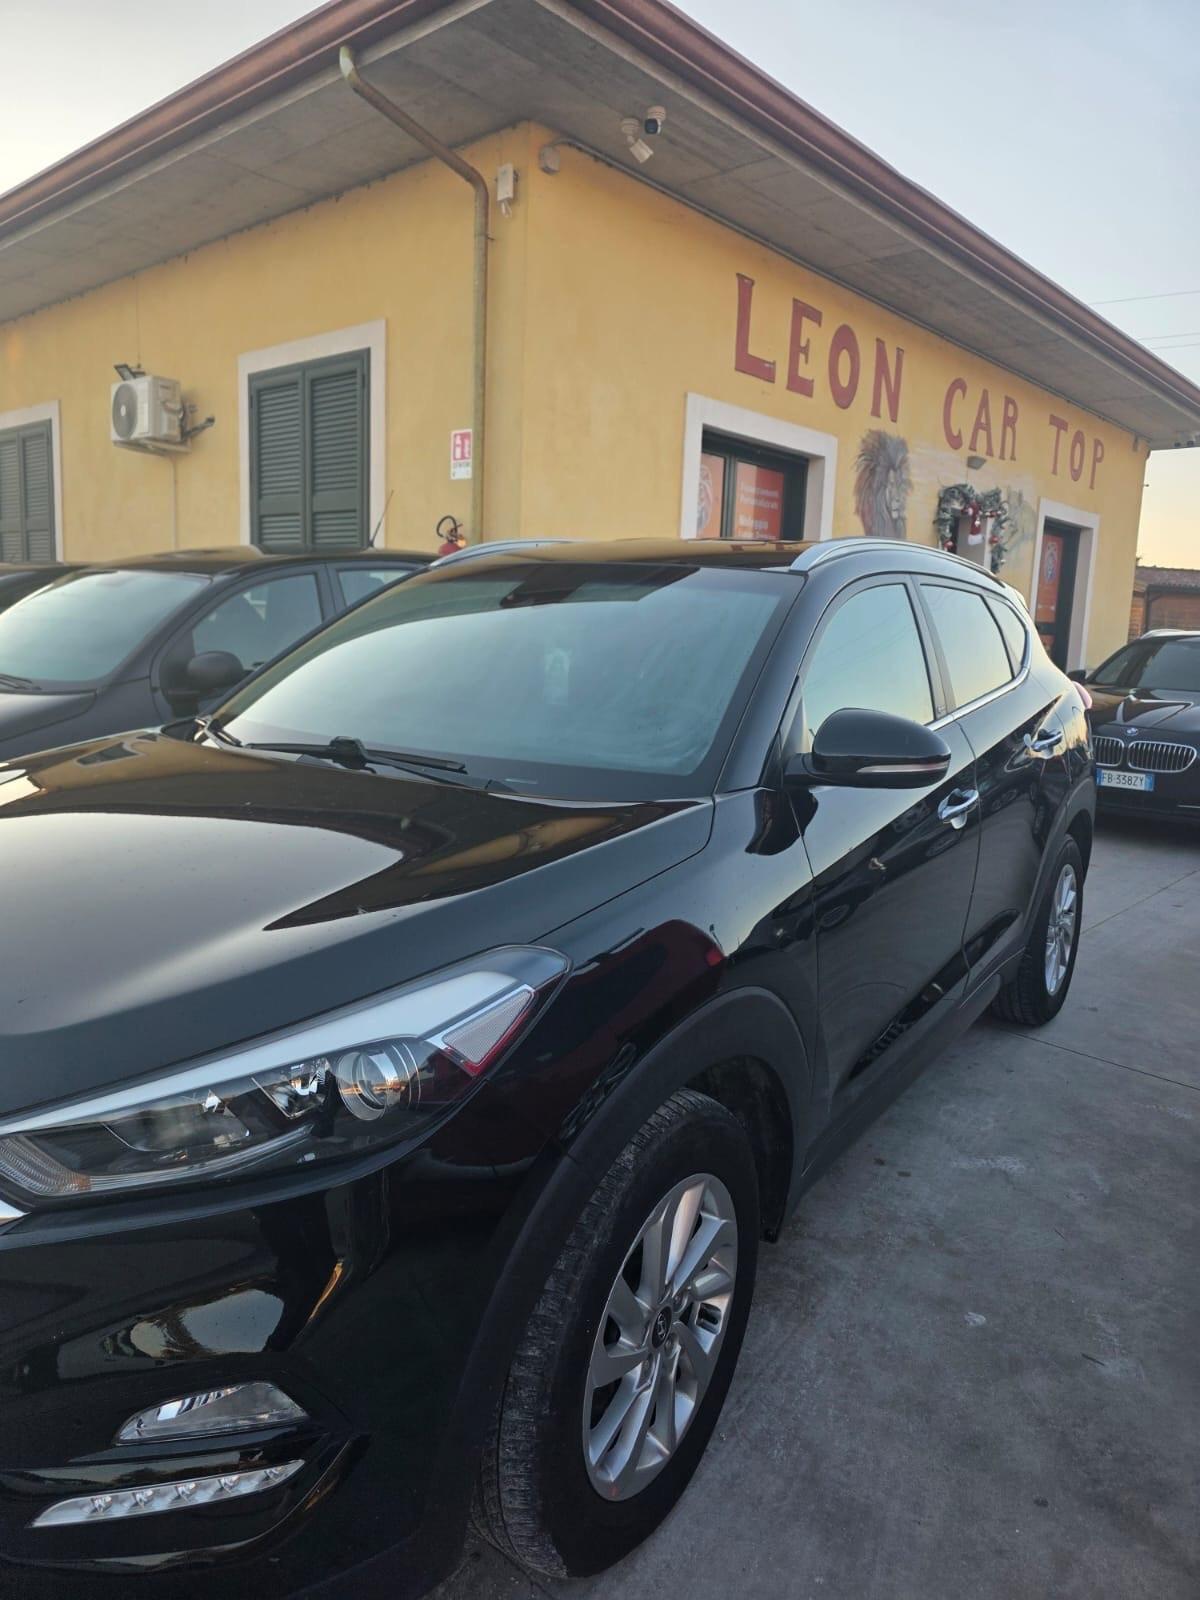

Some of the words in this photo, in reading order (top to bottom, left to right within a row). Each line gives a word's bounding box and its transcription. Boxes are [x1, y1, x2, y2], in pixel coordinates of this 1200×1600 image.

[735, 273, 905, 424] LEON
[942, 376, 1019, 462] CAR
[1048, 413, 1106, 490] TOP
